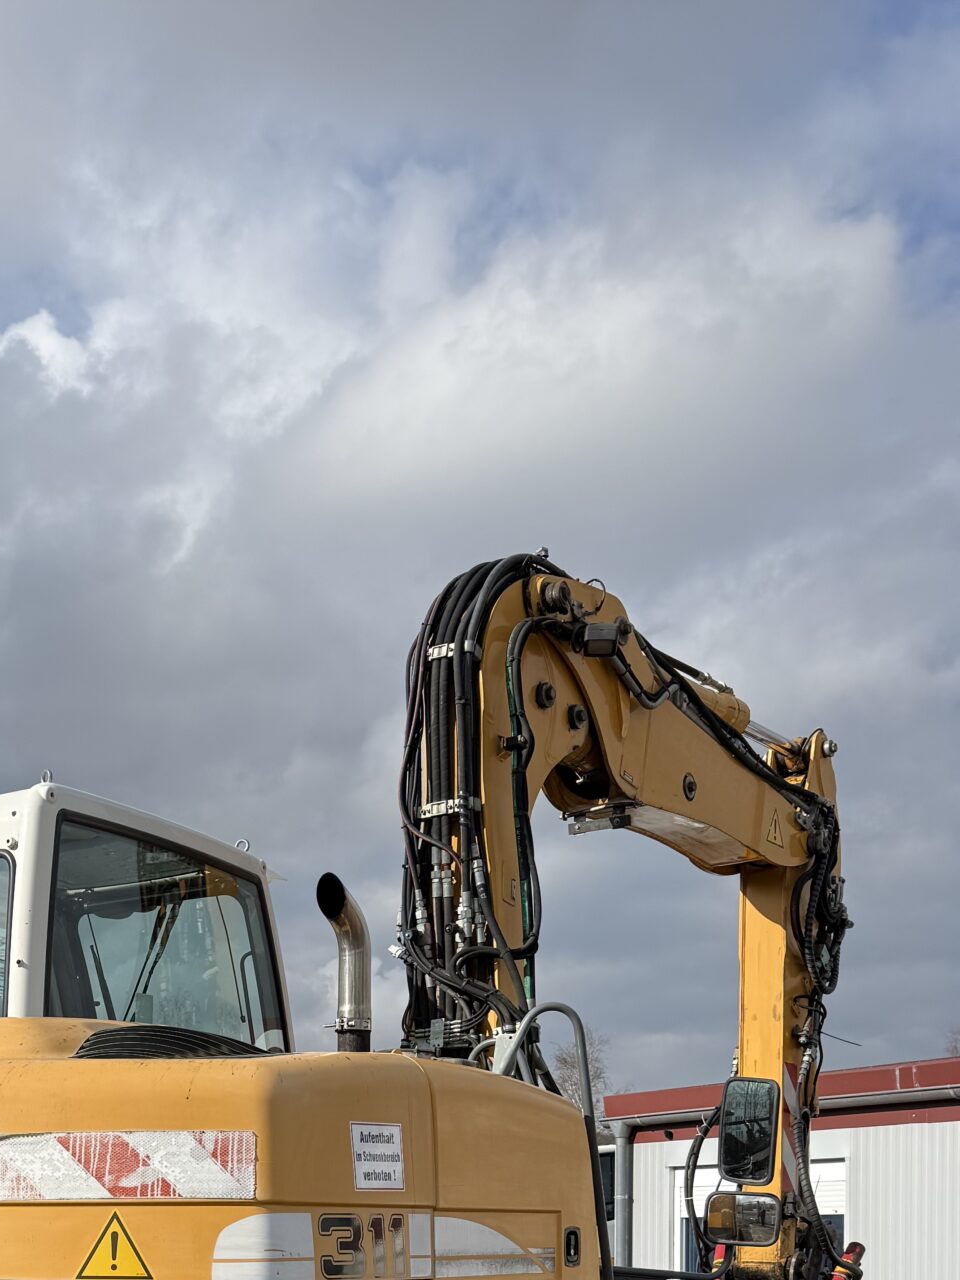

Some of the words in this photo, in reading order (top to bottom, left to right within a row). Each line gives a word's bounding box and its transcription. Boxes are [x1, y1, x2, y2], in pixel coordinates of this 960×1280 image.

[360, 1131, 395, 1144] Aufenthalt
[363, 1150, 401, 1163] Schwenkbereich
[363, 1169, 392, 1181] verboten
[318, 1213, 407, 1279] 311
